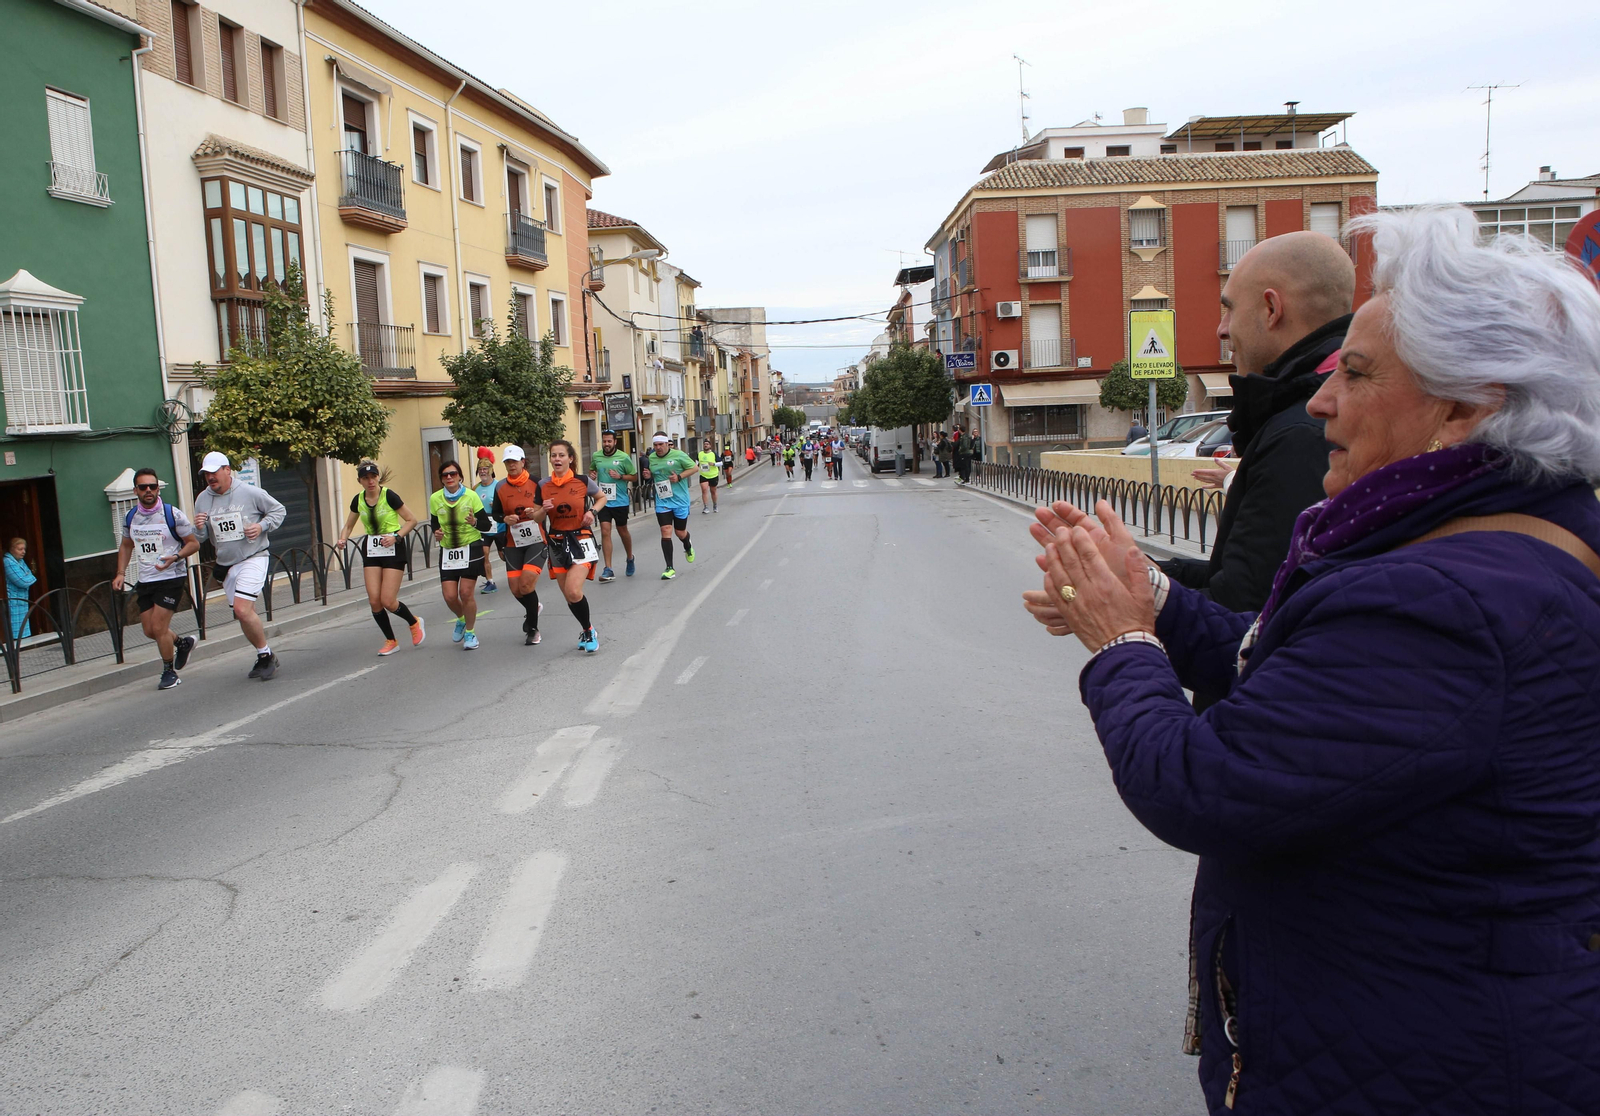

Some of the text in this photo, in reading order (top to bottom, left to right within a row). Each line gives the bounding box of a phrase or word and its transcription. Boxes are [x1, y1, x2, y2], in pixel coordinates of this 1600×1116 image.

[218, 520, 236, 532] 135
[519, 527, 532, 538] 38
[140, 543, 157, 553] 134
[448, 550, 464, 560] 601
